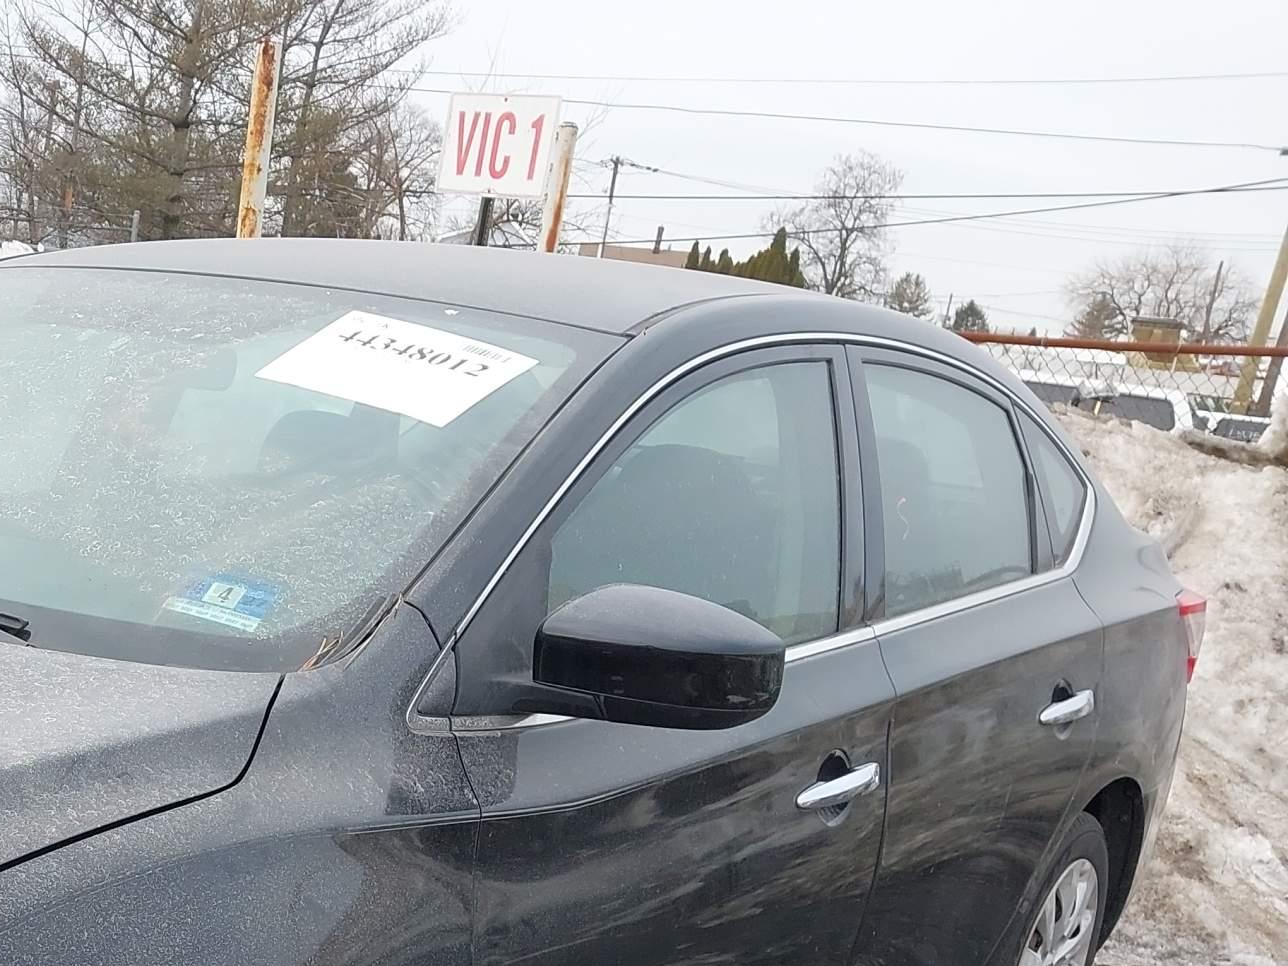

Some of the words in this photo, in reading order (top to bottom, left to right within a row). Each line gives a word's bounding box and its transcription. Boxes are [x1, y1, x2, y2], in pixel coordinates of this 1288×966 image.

[456, 111, 517, 179] VIC
[526, 113, 545, 181] 1
[338, 330, 489, 376] 44348012
[217, 587, 234, 603] 4
